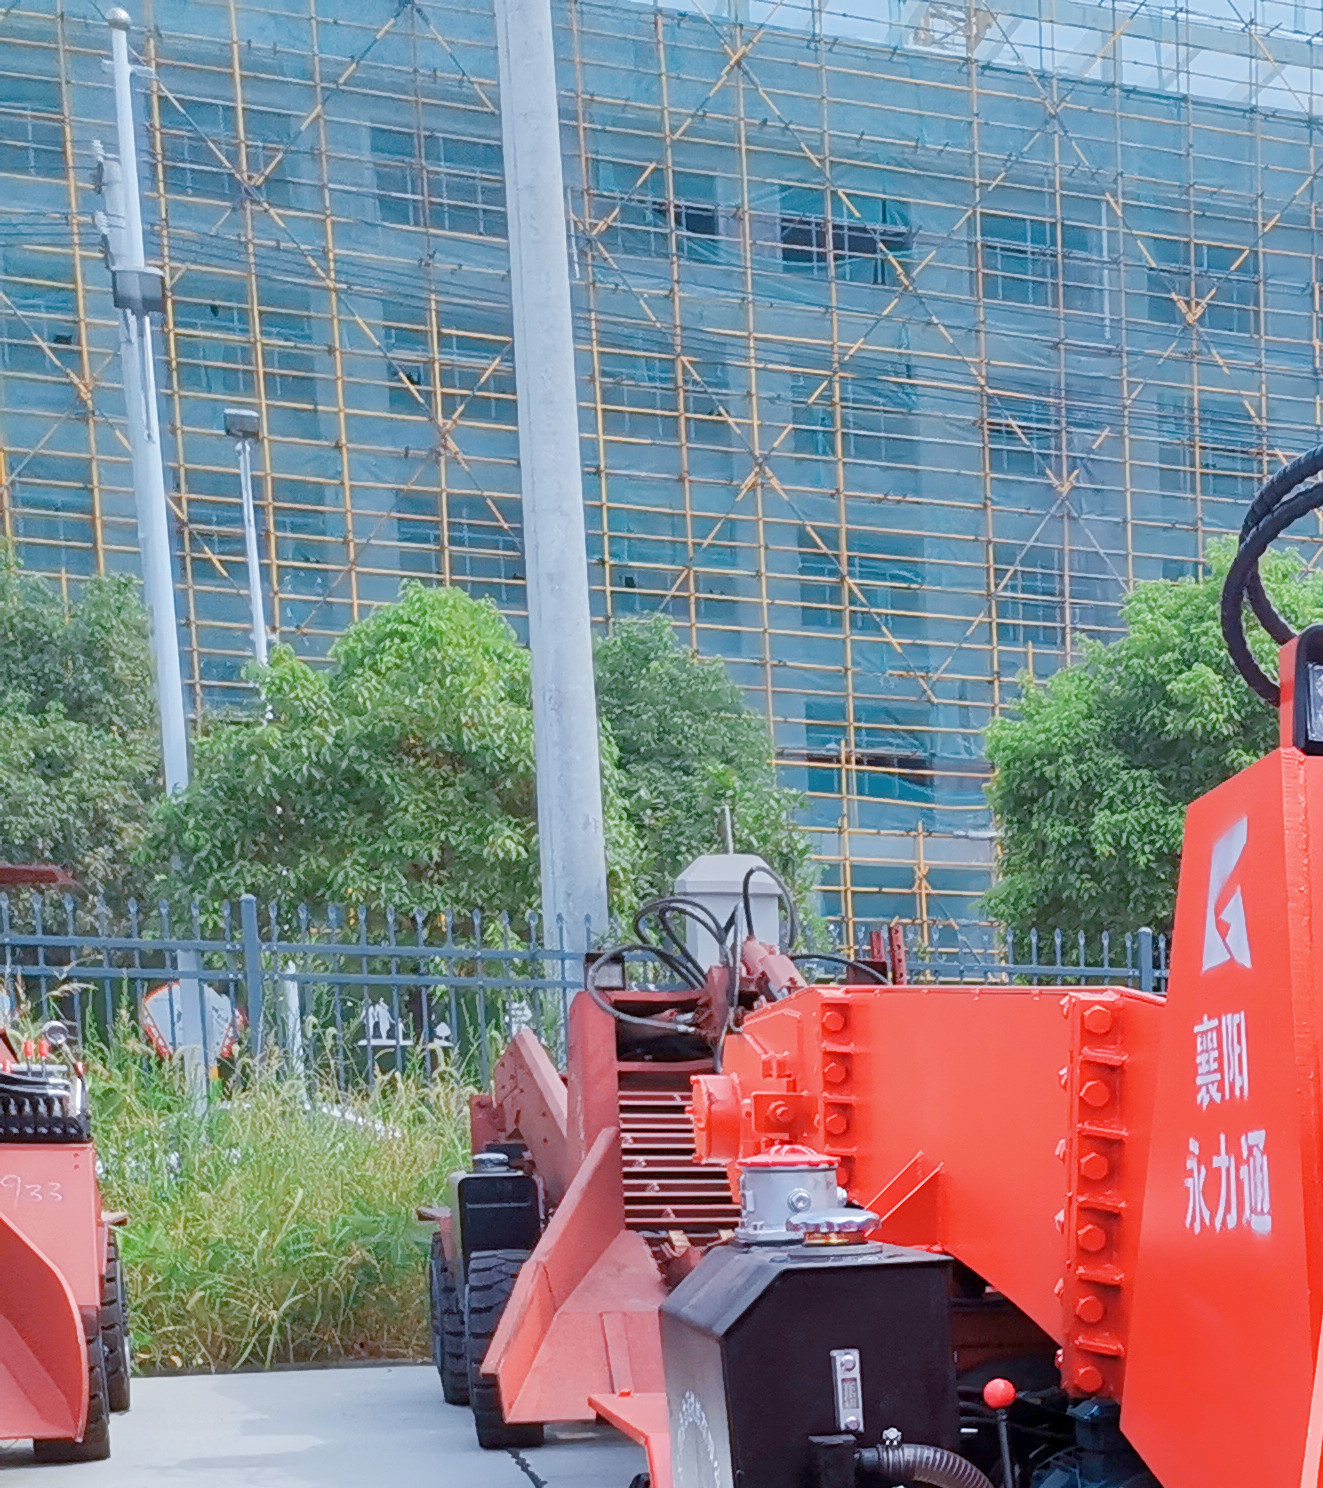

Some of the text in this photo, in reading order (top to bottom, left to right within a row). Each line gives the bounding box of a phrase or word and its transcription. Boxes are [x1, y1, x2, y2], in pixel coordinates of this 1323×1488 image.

[1194, 1010, 1249, 1109] 襄阳
[1185, 1129, 1272, 1235] 永力通
